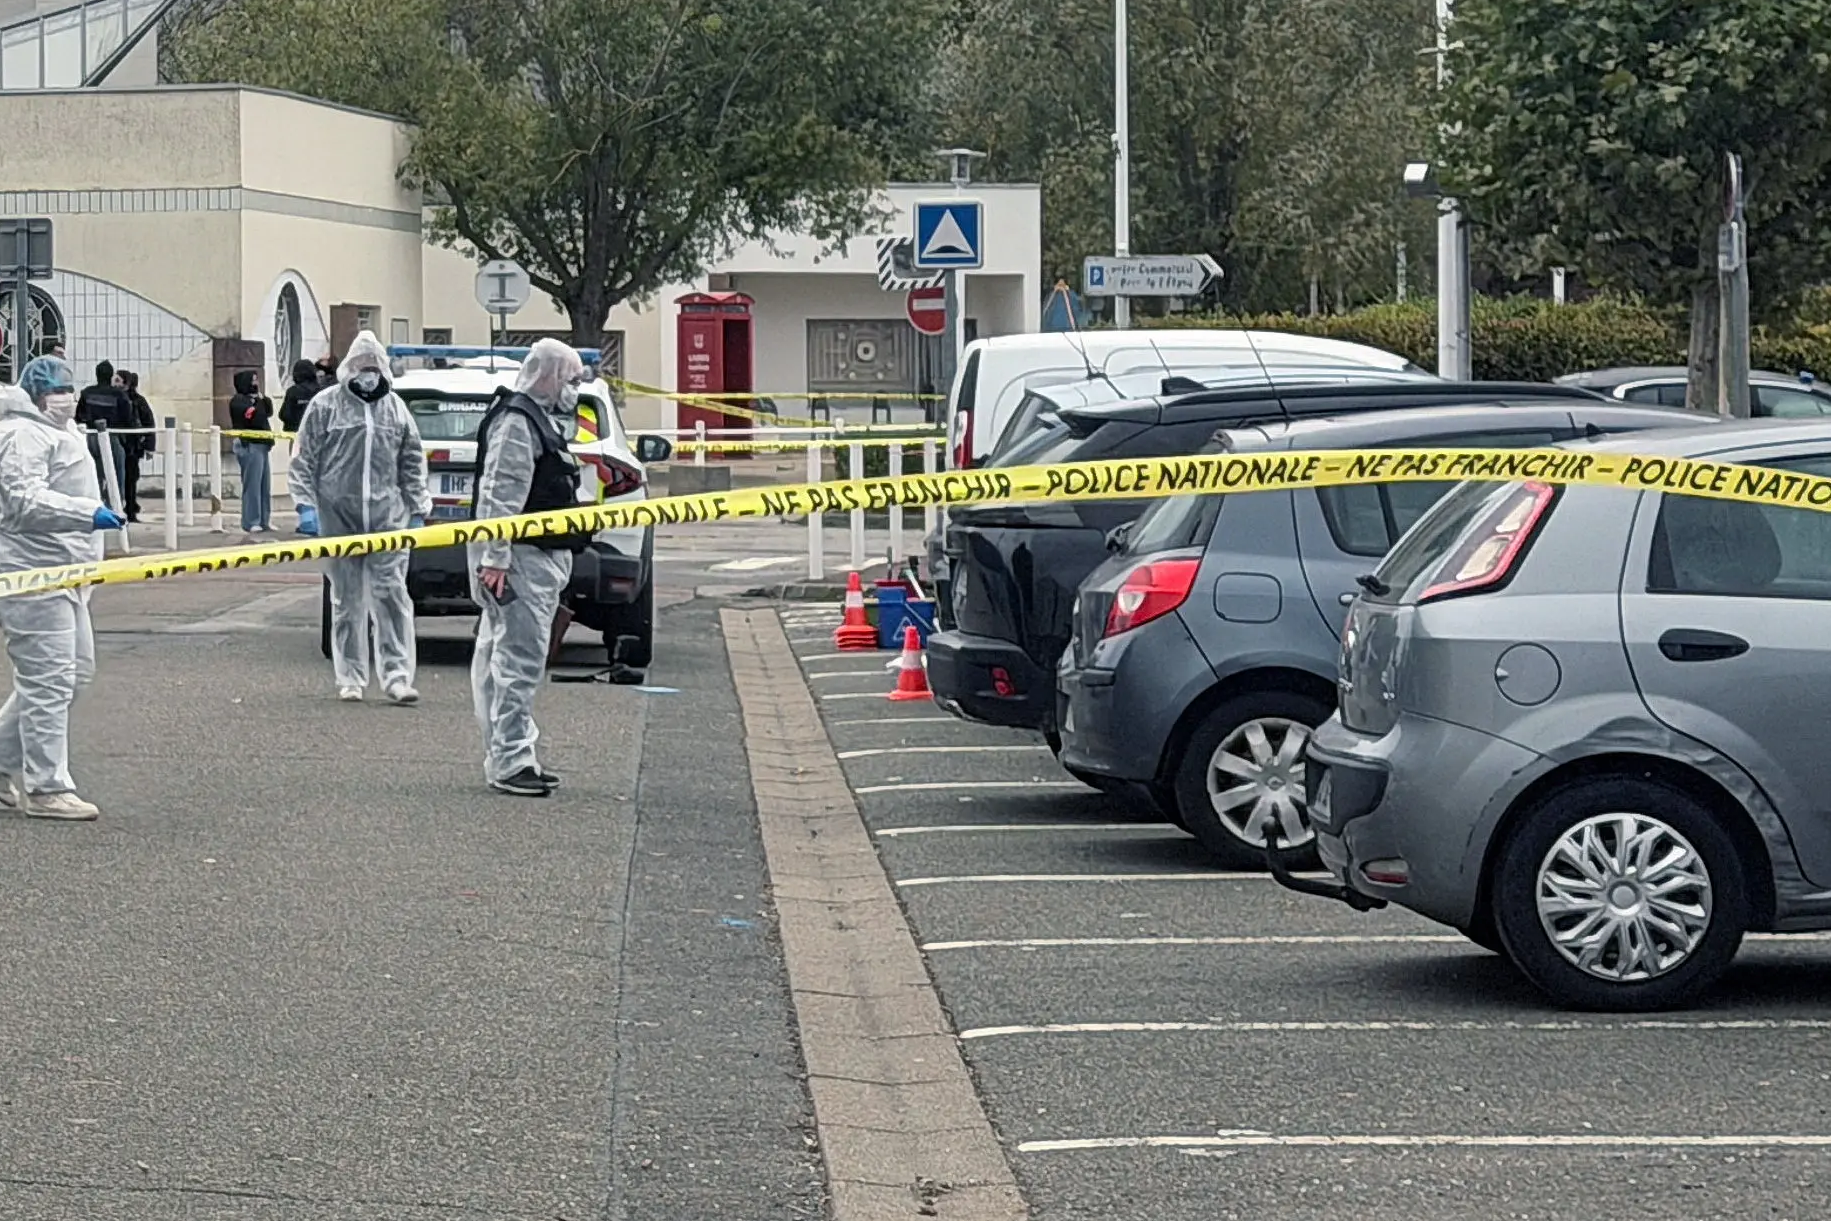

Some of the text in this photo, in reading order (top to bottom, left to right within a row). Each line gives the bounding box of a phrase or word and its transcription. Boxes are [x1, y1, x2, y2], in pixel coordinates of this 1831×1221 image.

[438, 402, 488, 412] BRIGAD
[564, 497, 730, 534] NATIONALE
[760, 490, 799, 517] NE
[806, 485, 859, 513] PAS
[862, 472, 1012, 509] FRANCHIR
[1045, 463, 1151, 497] POLICE
[1155, 455, 1322, 491] NATIONALE
[1345, 454, 1393, 479] NE
[1390, 453, 1444, 477] PAS
[1445, 453, 1594, 480] FRANCHIR
[1619, 457, 1733, 493] POLICE
